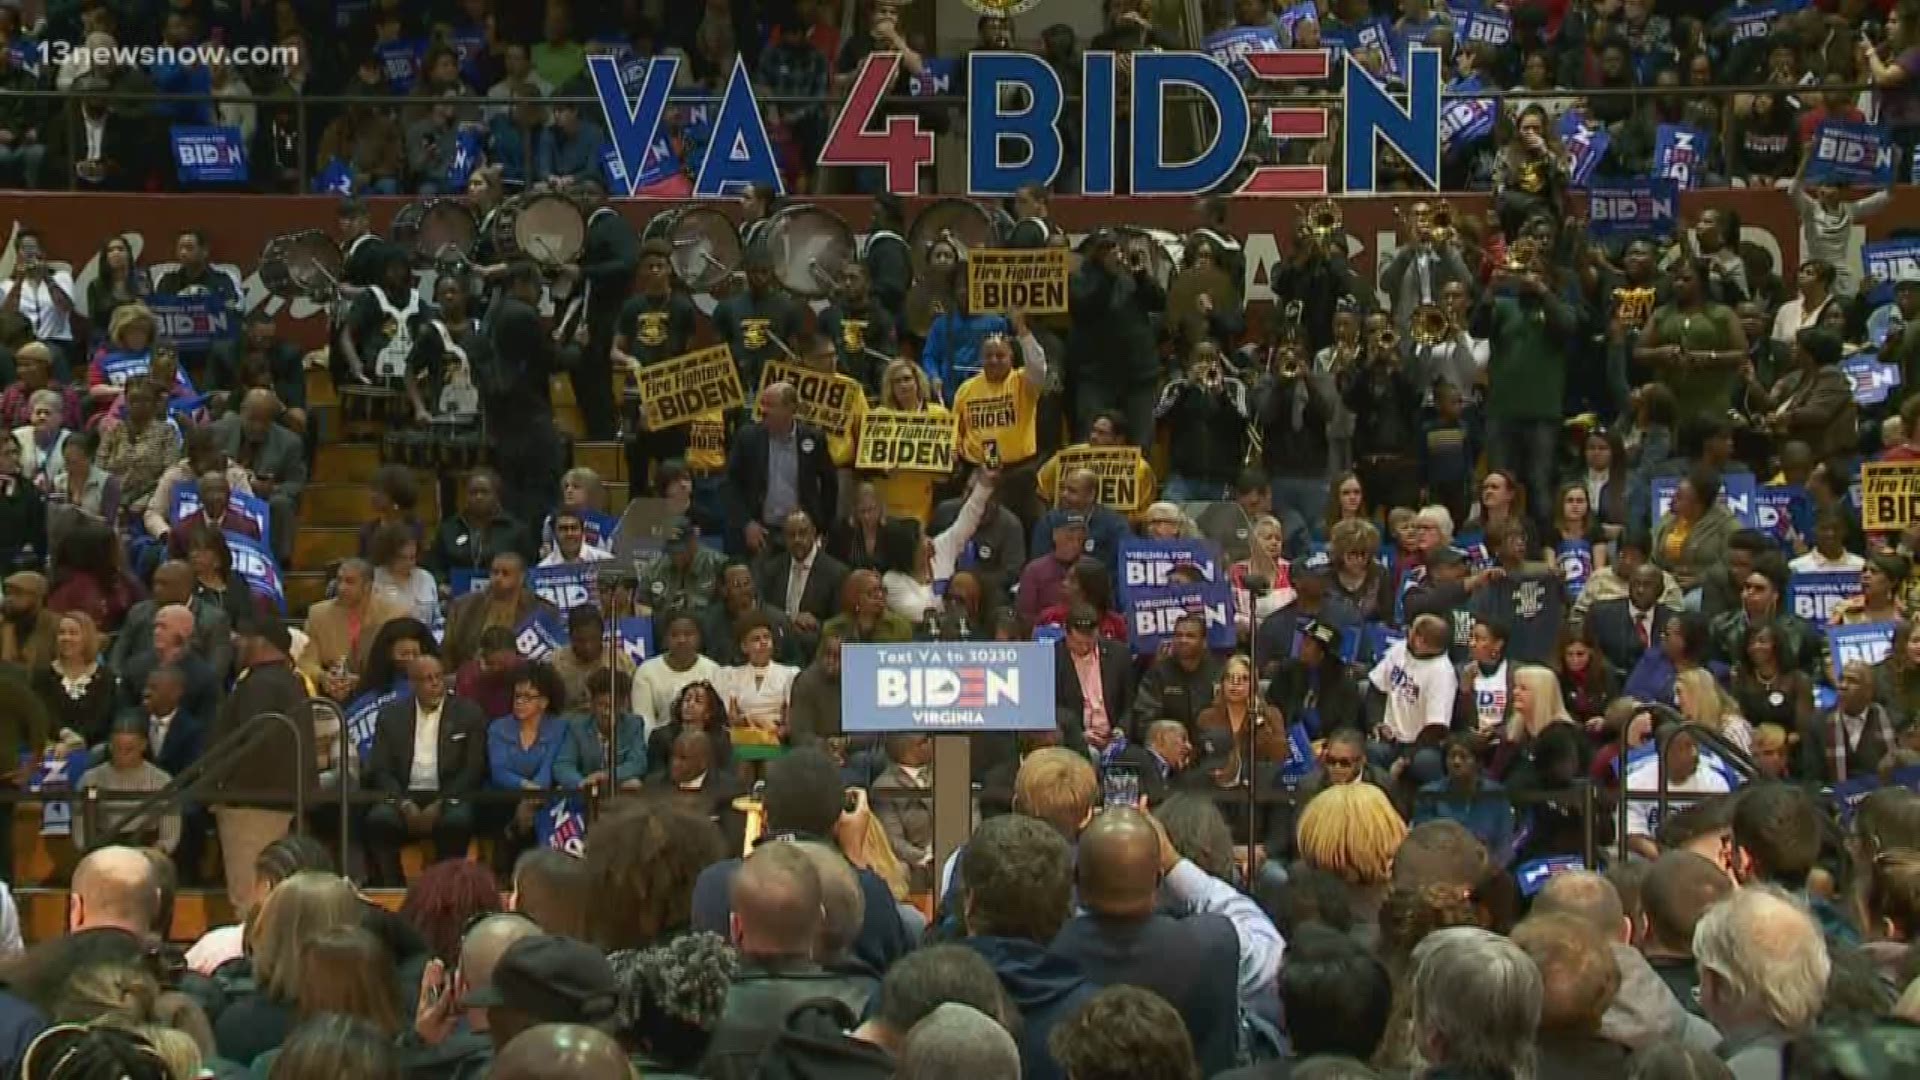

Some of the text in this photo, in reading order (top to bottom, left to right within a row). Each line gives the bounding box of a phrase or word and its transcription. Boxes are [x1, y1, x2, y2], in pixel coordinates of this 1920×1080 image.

[587, 48, 1441, 197] VA 4 BIDEN
[179, 143, 242, 166] BIDEN
[1818, 136, 1892, 168] BIDEN
[1592, 197, 1671, 220] BIDEN
[984, 282, 1064, 308] BIDEN
[657, 376, 740, 421] BIDEN
[970, 410, 1016, 428] BIDEN
[871, 440, 952, 467] BIDEN
[1127, 560, 1214, 584] BIDN
[1136, 602, 1226, 636] BIDN
[878, 649, 1018, 663] Text VA to 30330
[877, 667, 1019, 707] BIDEN
[912, 711, 985, 725] VIRGINIA
